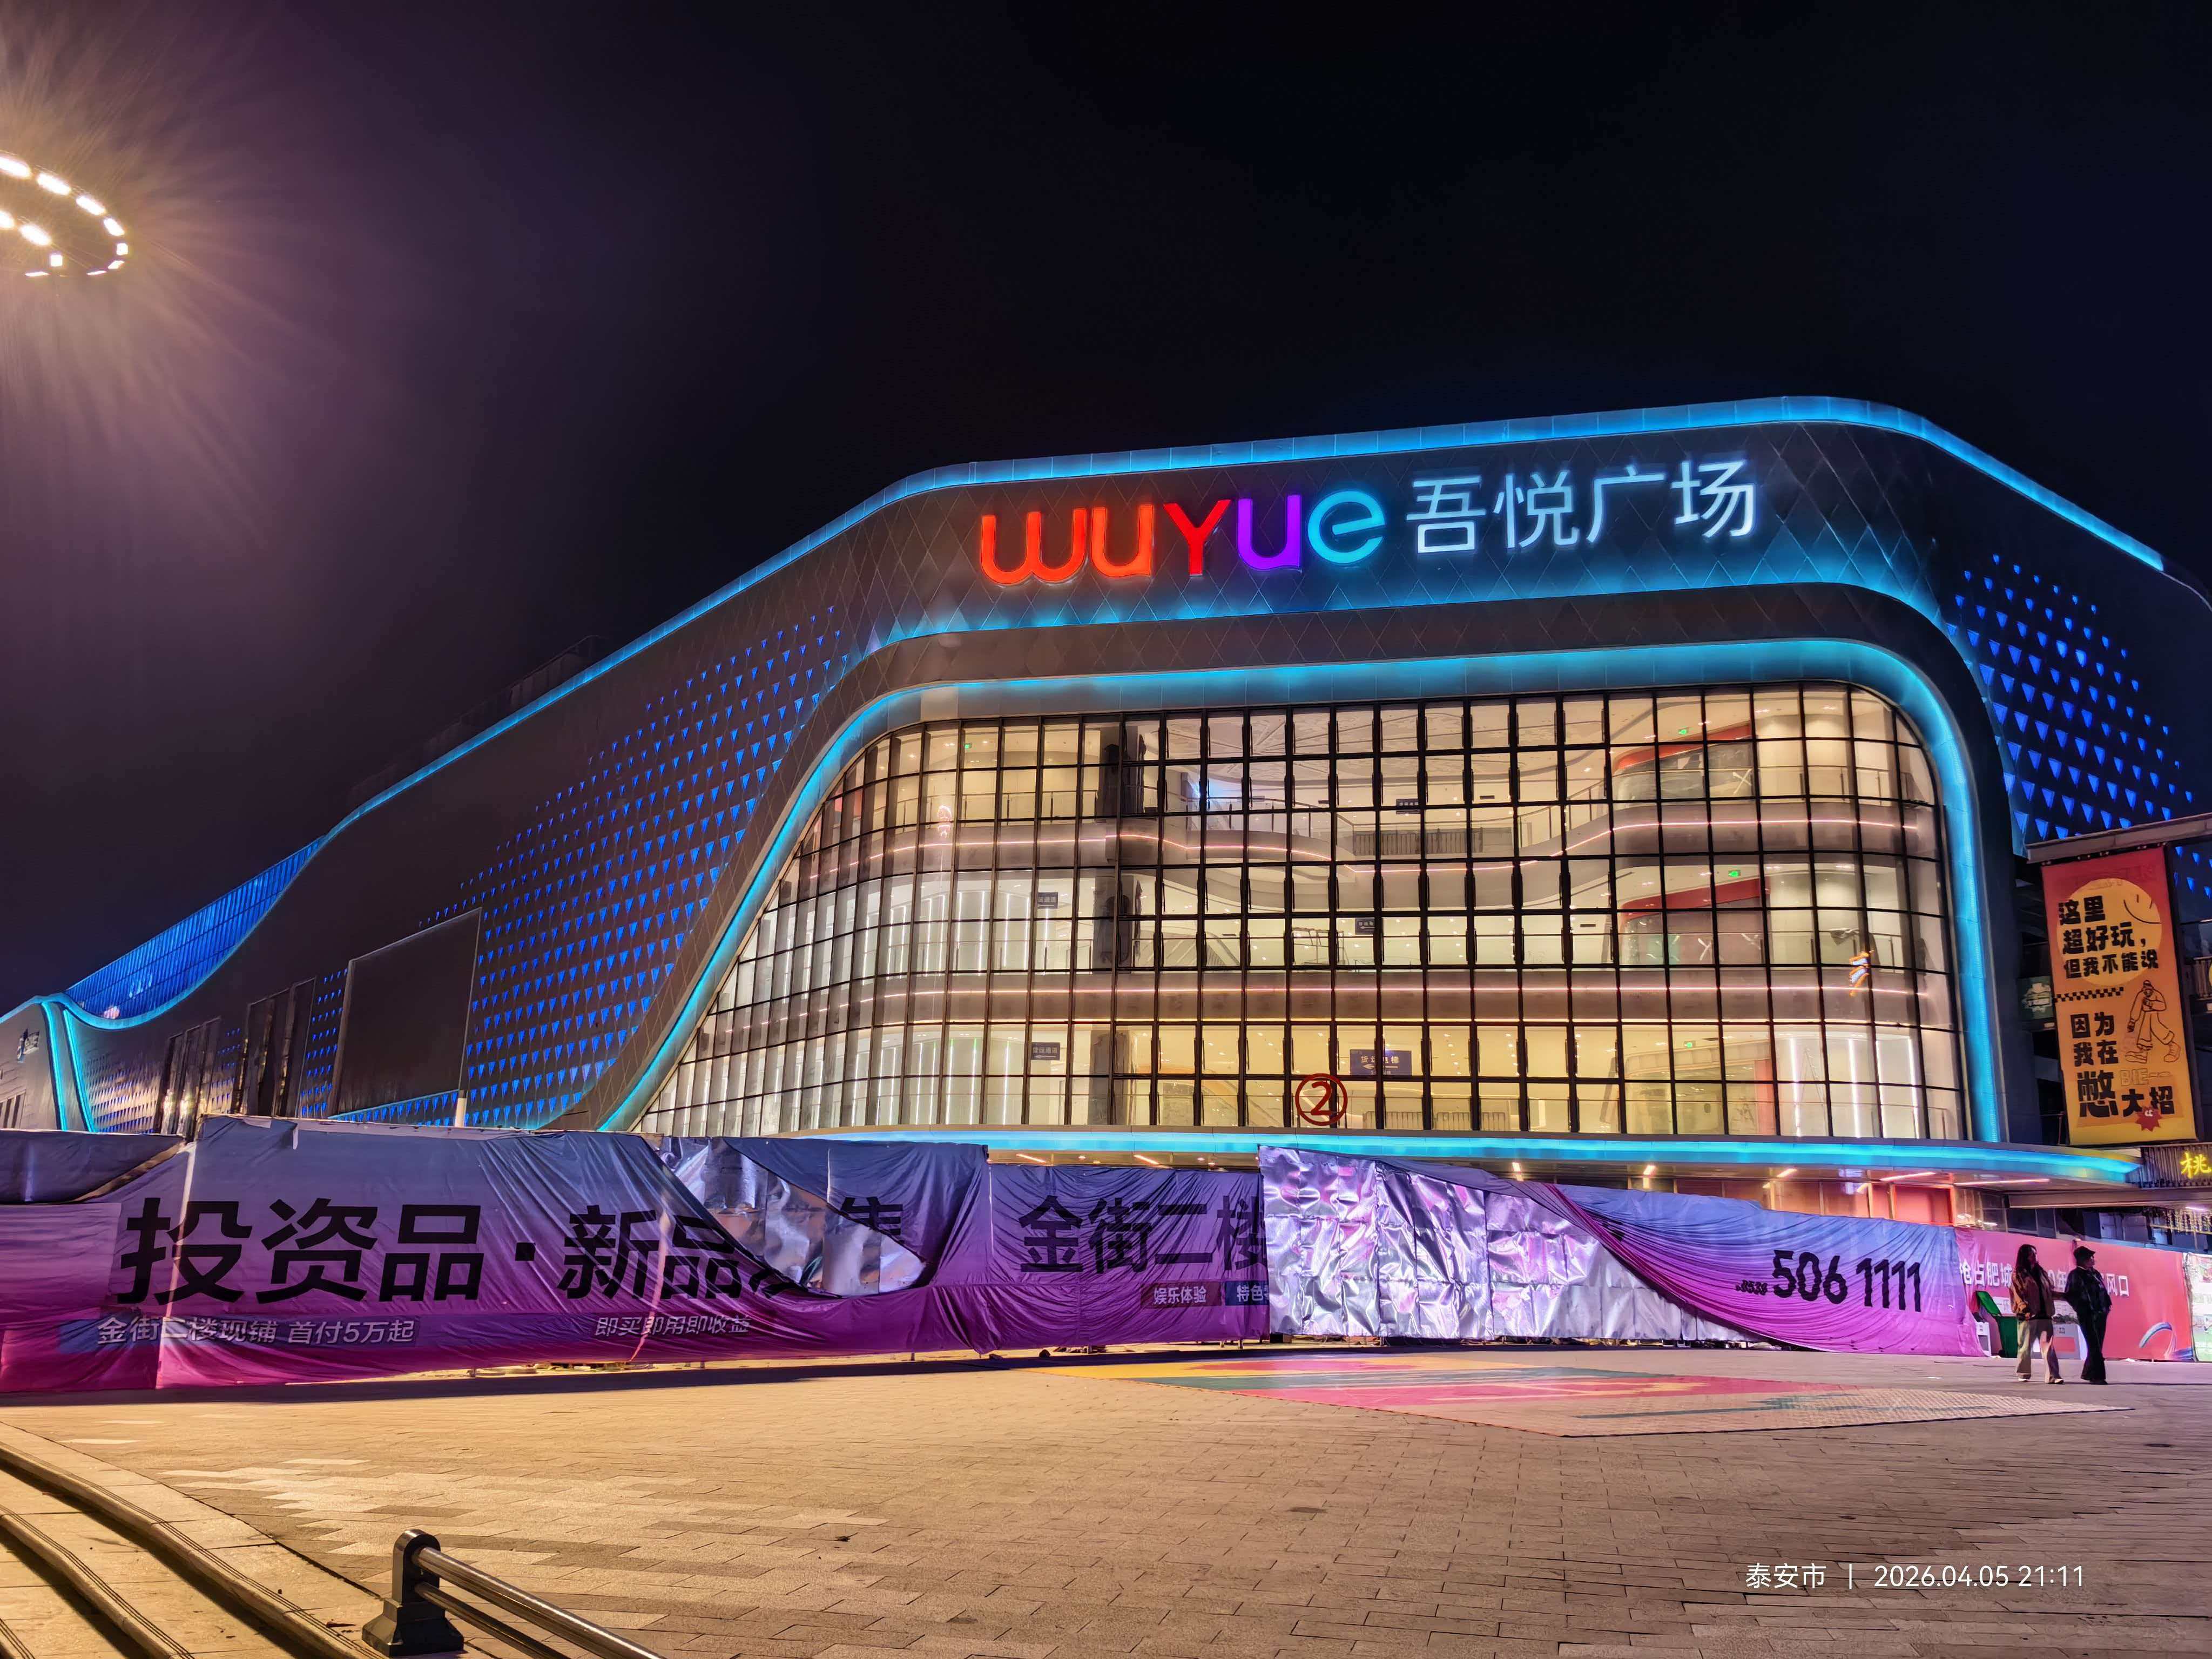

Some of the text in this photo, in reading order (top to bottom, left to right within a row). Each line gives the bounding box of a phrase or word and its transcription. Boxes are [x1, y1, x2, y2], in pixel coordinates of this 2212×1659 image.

[1406, 459, 1757, 554] 吾悦广场
[2058, 895, 2105, 925] 这里
[2063, 949, 2159, 979] 但我不能说
[2071, 1011, 2114, 1038] 因为
[2073, 1040, 2119, 1067] 我在
[1772, 1250, 1847, 1305] 506
[1856, 1258, 1921, 1312] 1111
[1154, 1286, 1208, 1304] 娱乐体验
[288, 1320, 415, 1344] 首付5万起
[595, 1315, 751, 1337] 即买即用即收益
